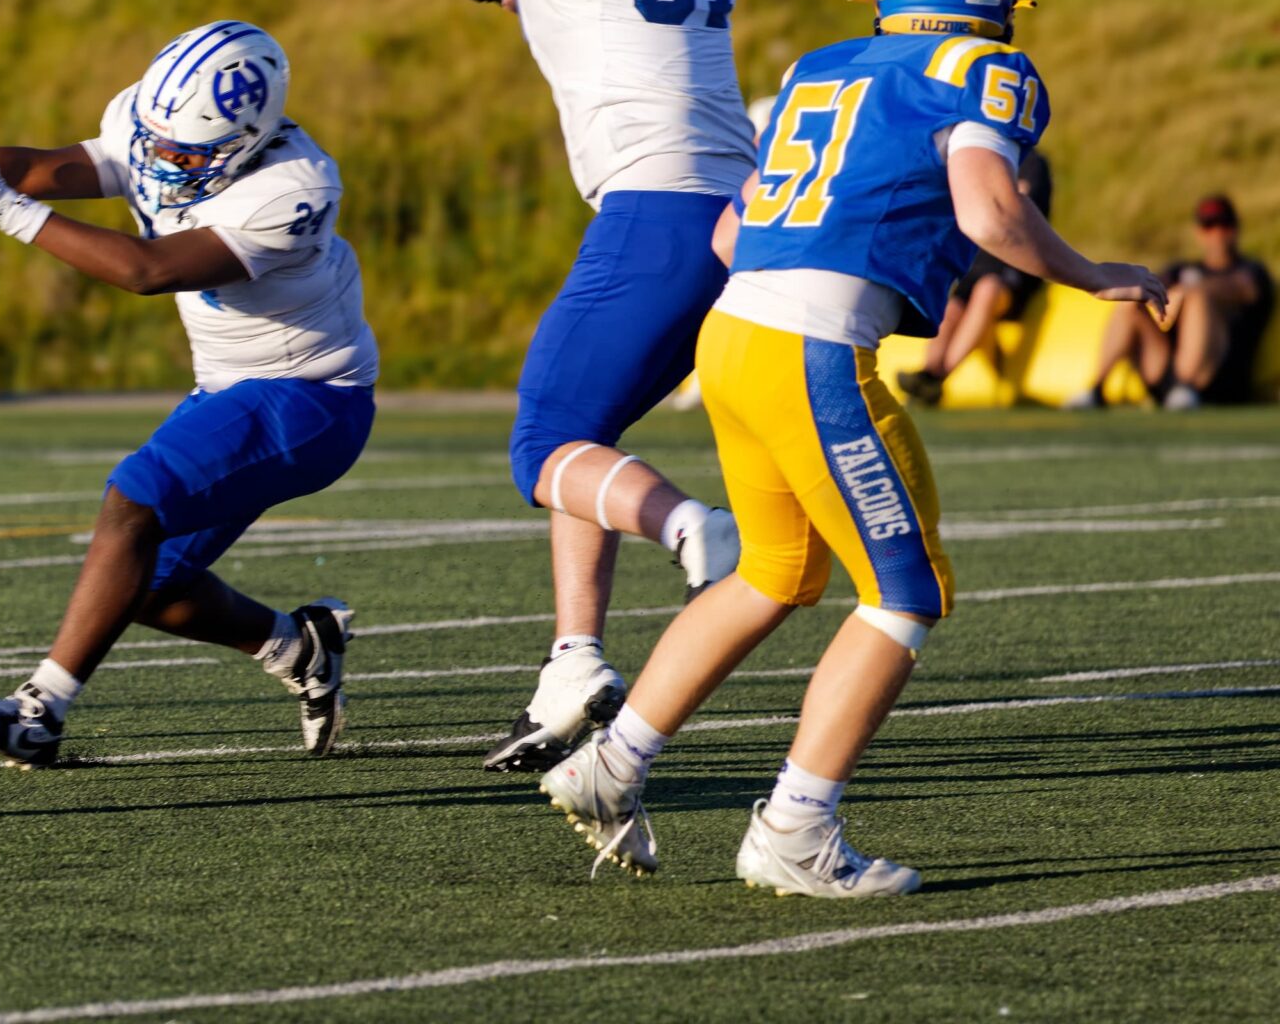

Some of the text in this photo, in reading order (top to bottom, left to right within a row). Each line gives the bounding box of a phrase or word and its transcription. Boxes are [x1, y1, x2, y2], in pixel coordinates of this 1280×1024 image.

[980, 64, 1040, 133] 51
[741, 77, 874, 228] 51
[831, 434, 911, 541] FALCONS
